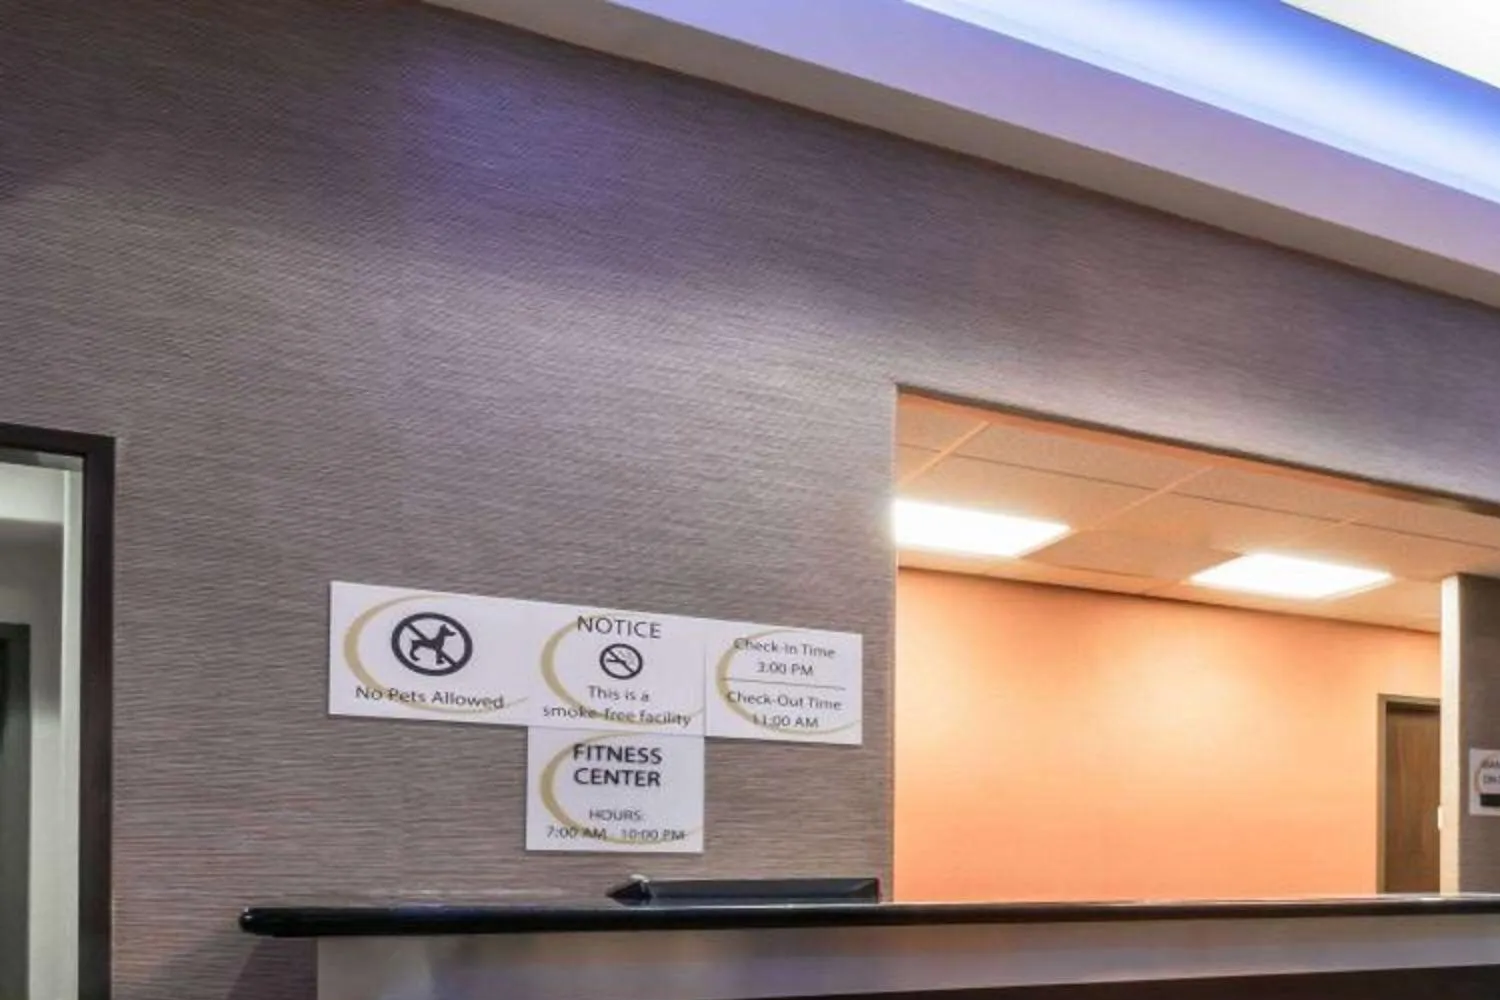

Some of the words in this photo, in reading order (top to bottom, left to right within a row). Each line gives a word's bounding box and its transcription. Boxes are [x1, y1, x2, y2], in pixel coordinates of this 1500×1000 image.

[578, 615, 662, 639] NOTICE
[802, 643, 836, 658] Time
[791, 663, 814, 676] PM
[355, 685, 383, 701] No
[388, 687, 426, 703] Pets
[431, 690, 505, 710] Allowed
[588, 685, 620, 700] This
[625, 689, 636, 700] is
[640, 693, 650, 703] a
[808, 696, 843, 711] Time
[639, 709, 692, 729] facility
[795, 716, 819, 729] AM
[573, 743, 663, 765] FITNESS
[573, 767, 662, 788] CENTER
[546, 826, 578, 840] 7:00
[581, 827, 608, 841] AM
[662, 829, 686, 842] PM
